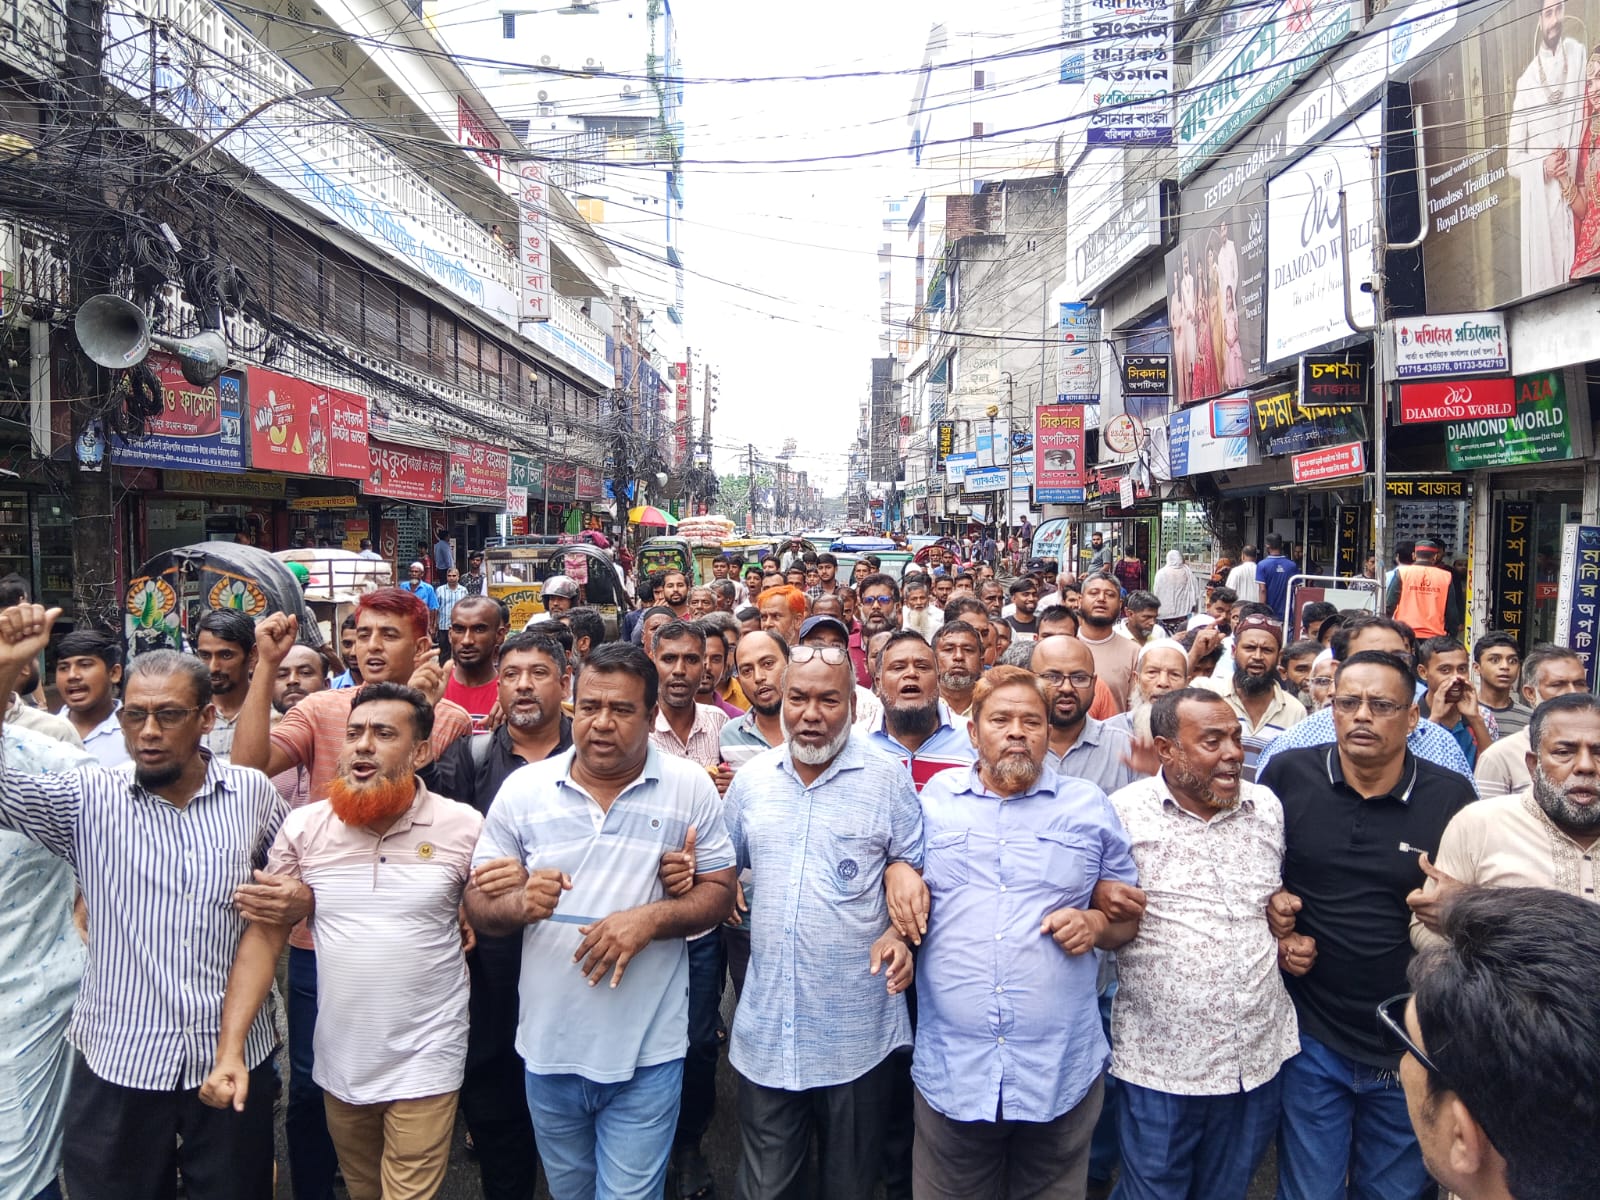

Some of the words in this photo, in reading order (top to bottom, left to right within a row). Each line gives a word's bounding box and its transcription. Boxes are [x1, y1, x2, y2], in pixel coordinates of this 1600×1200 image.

[1094, 66, 1168, 82] বর্তমান
[1091, 112, 1134, 126] সোনার
[1136, 112, 1168, 125] বাংলা
[1204, 172, 1236, 211] TESTED
[1235, 130, 1284, 191] GLOBALLY
[1453, 157, 1469, 174] world
[522, 165, 543, 226] হোটেল
[1428, 187, 1463, 214] Timeless
[1463, 166, 1505, 195] Tradition
[1436, 215, 1459, 232] Royal
[1460, 194, 1498, 220] Elegance
[372, 202, 417, 258] লিমিটেড
[1274, 244, 1327, 290] DIAMOND
[1329, 219, 1373, 262] WRL
[528, 237, 542, 312] গুলবাগ
[1414, 323, 1453, 348] দখিনের
[1455, 321, 1501, 344] প্রতিবেদন
[1128, 366, 1166, 380] সিকদার
[1309, 361, 1361, 380] চশমা
[1399, 362, 1452, 374] 01715-436976,
[1454, 359, 1504, 370] 01733-542719
[1311, 383, 1361, 396] বাজার
[179, 386, 217, 421] ফার্মেসী
[1255, 393, 1294, 431] চশমা
[1405, 405, 1465, 420] DIAMOND
[1467, 403, 1512, 416] WORLD
[1040, 413, 1080, 429] সিকদার
[1448, 418, 1508, 441] DIAMOND
[1510, 407, 1563, 431] WORLD
[368, 447, 408, 479] অংকুর
[472, 448, 485, 465] এফ
[486, 451, 508, 471] রহমান
[513, 463, 528, 484] বুক
[971, 474, 1006, 486] ল্যাবএইড
[1385, 482, 1413, 495] শমা
[1417, 482, 1462, 495] বাজার
[1341, 511, 1355, 562] চশমা
[1505, 515, 1527, 581] চশমা
[1579, 549, 1600, 598] মনির
[502, 590, 534, 609] রশেদ
